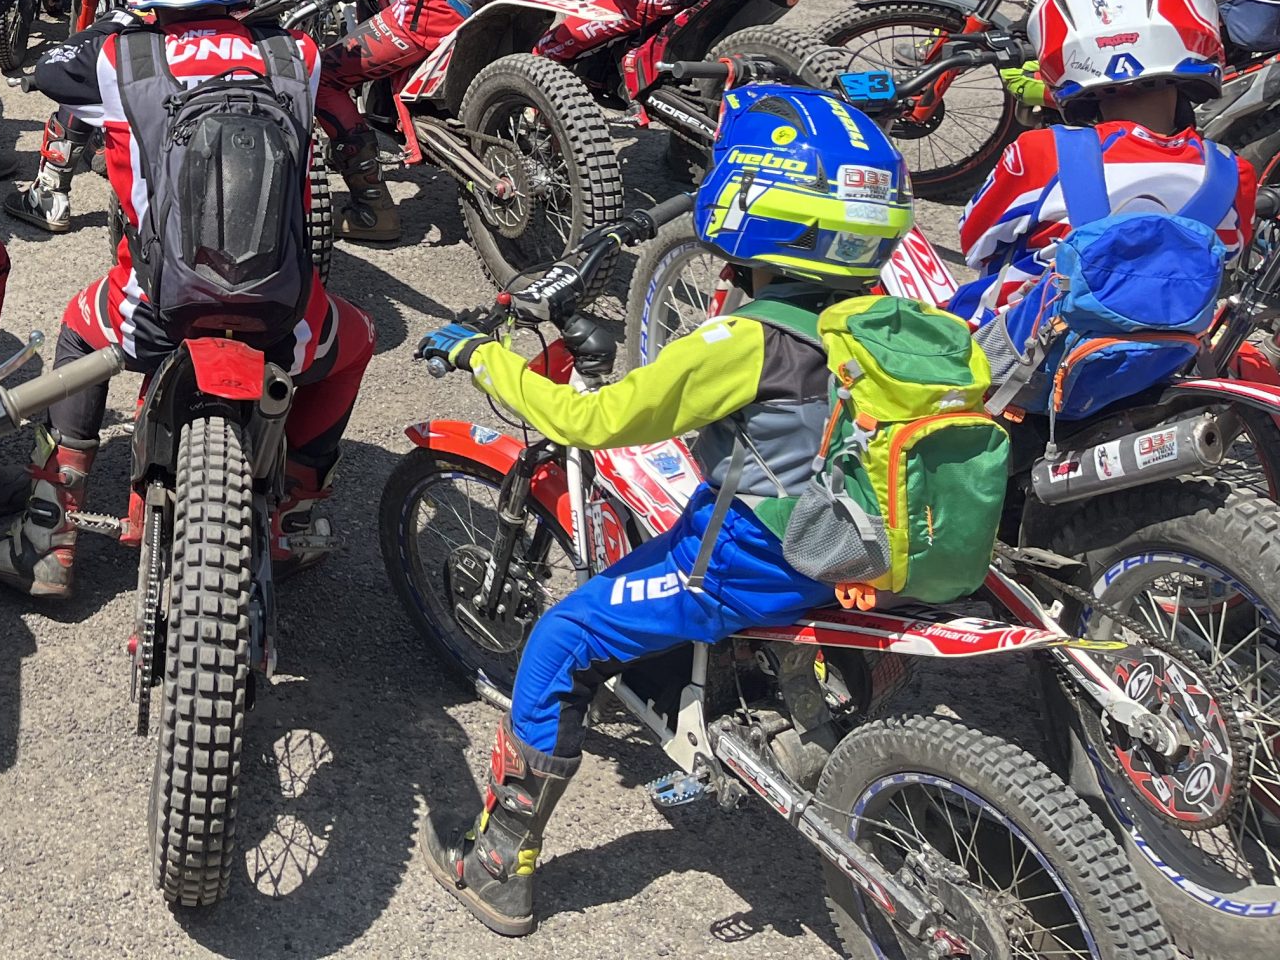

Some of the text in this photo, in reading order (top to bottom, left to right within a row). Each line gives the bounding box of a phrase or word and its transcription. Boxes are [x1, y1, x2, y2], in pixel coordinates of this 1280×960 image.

[647, 94, 717, 137] MOREN
[727, 149, 808, 174] hebo
[914, 622, 982, 644] Stylmartin
